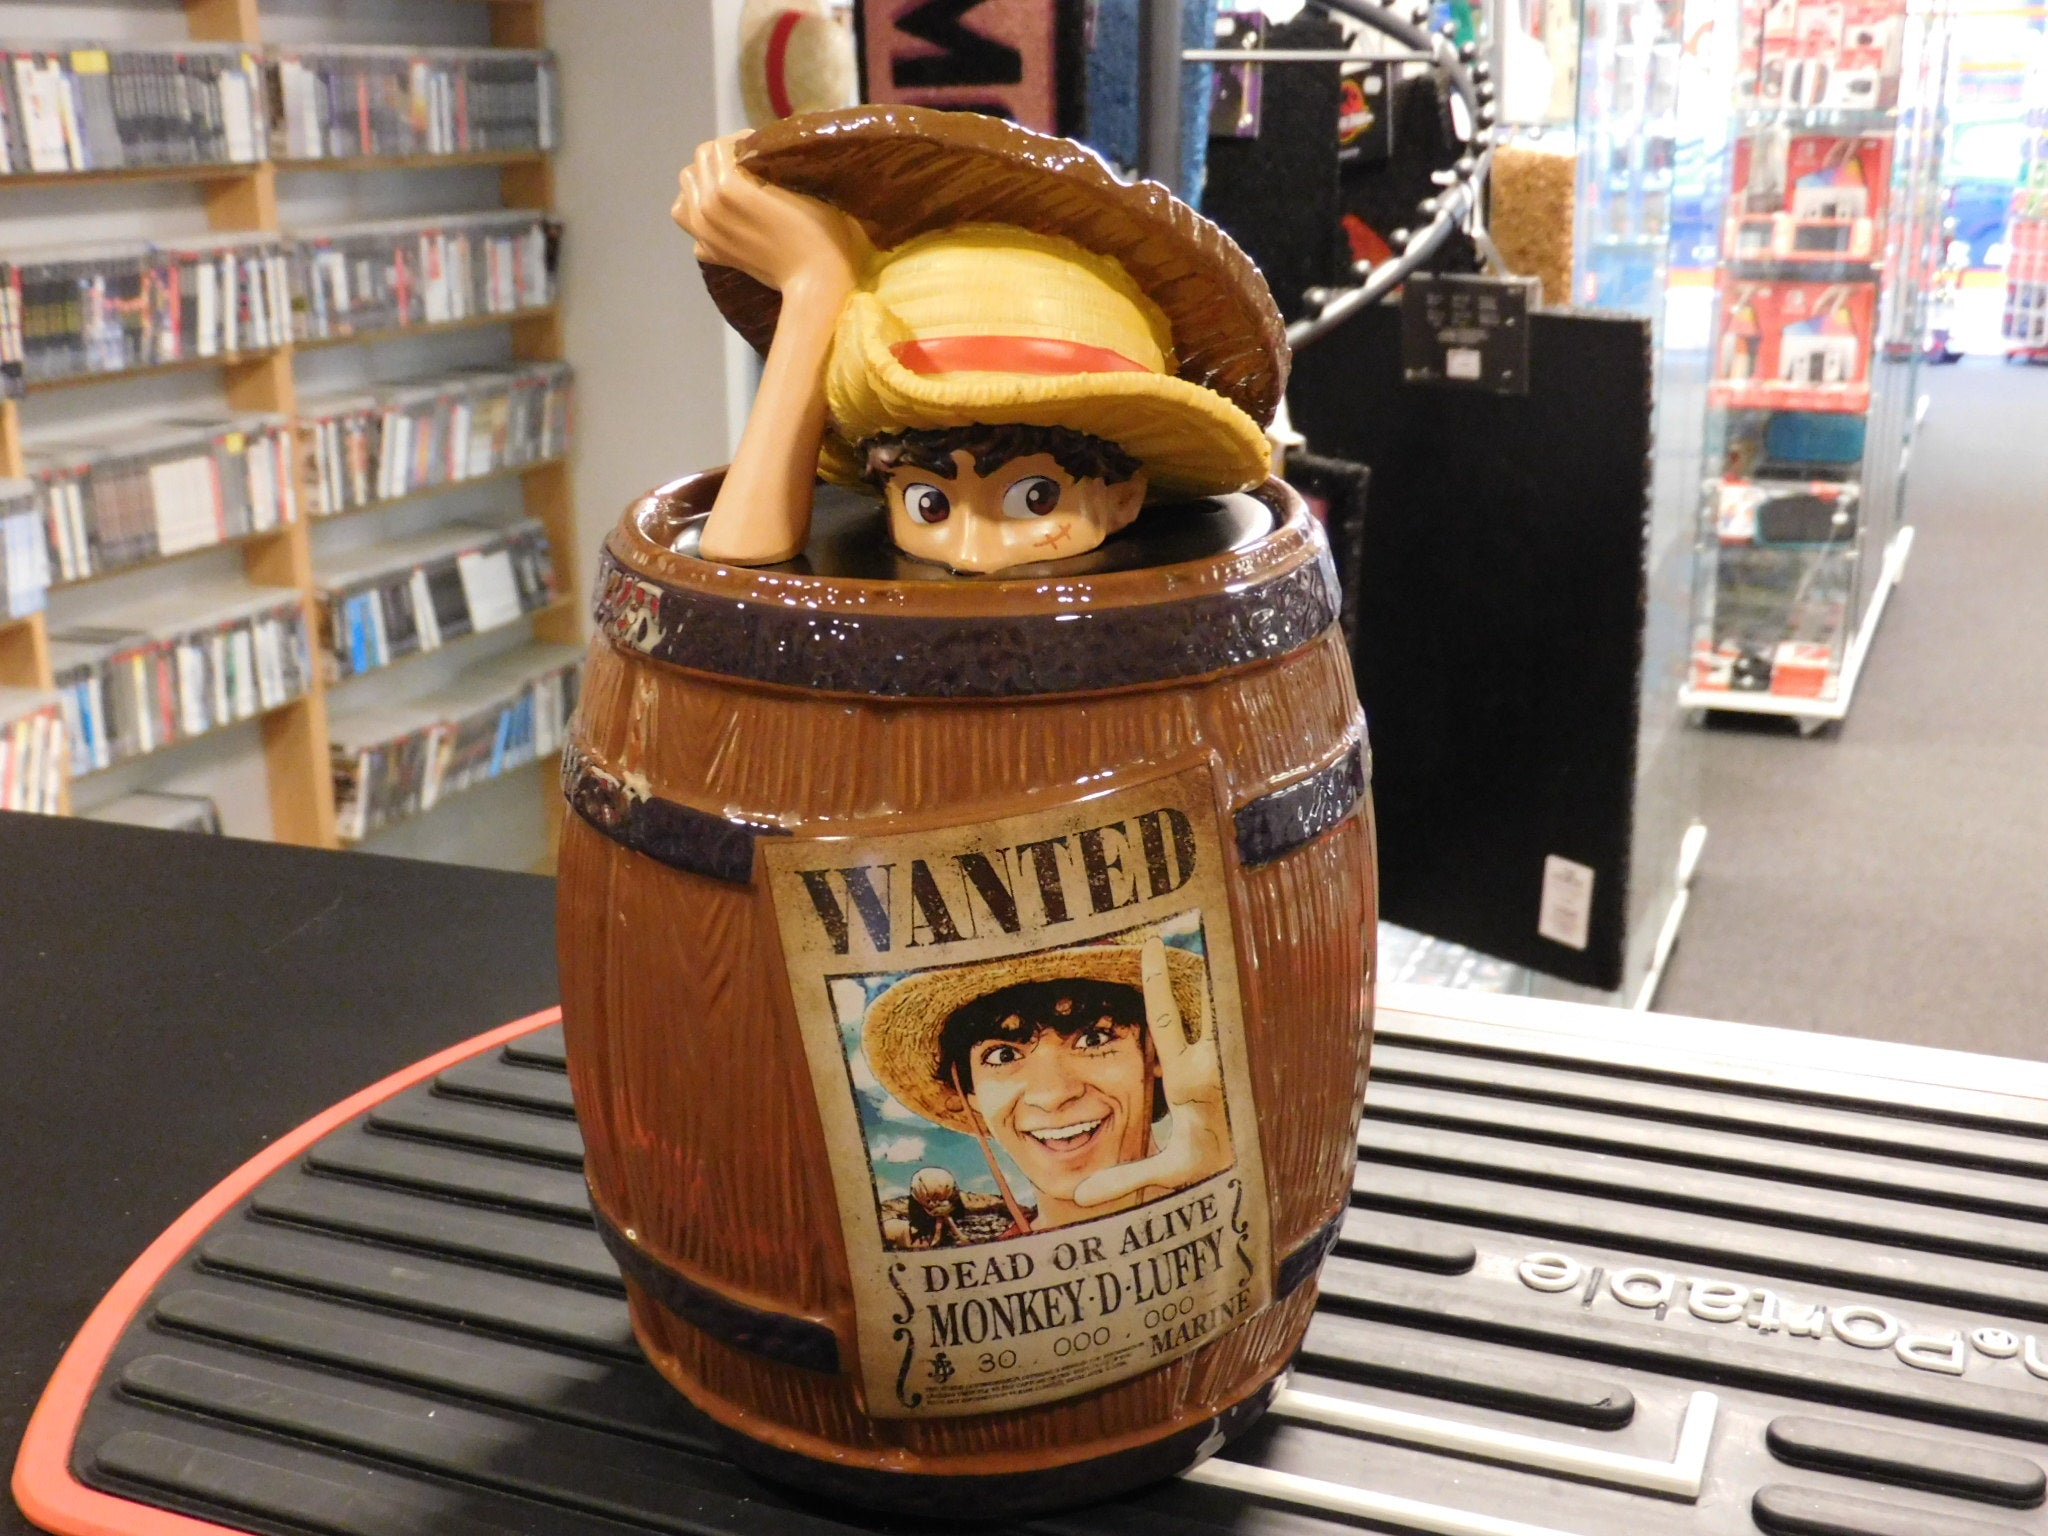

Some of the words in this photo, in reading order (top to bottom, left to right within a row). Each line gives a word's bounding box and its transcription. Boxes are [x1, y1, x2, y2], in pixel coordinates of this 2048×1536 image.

[794, 807, 1197, 955] WANTED
[921, 1252, 1035, 1292] DEAD
[1052, 1236, 1107, 1271] OR
[1119, 1193, 1219, 1255] ALIVE
[1150, 1288, 1251, 1358] MARINE
[1518, 1251, 1965, 1376] Portable
